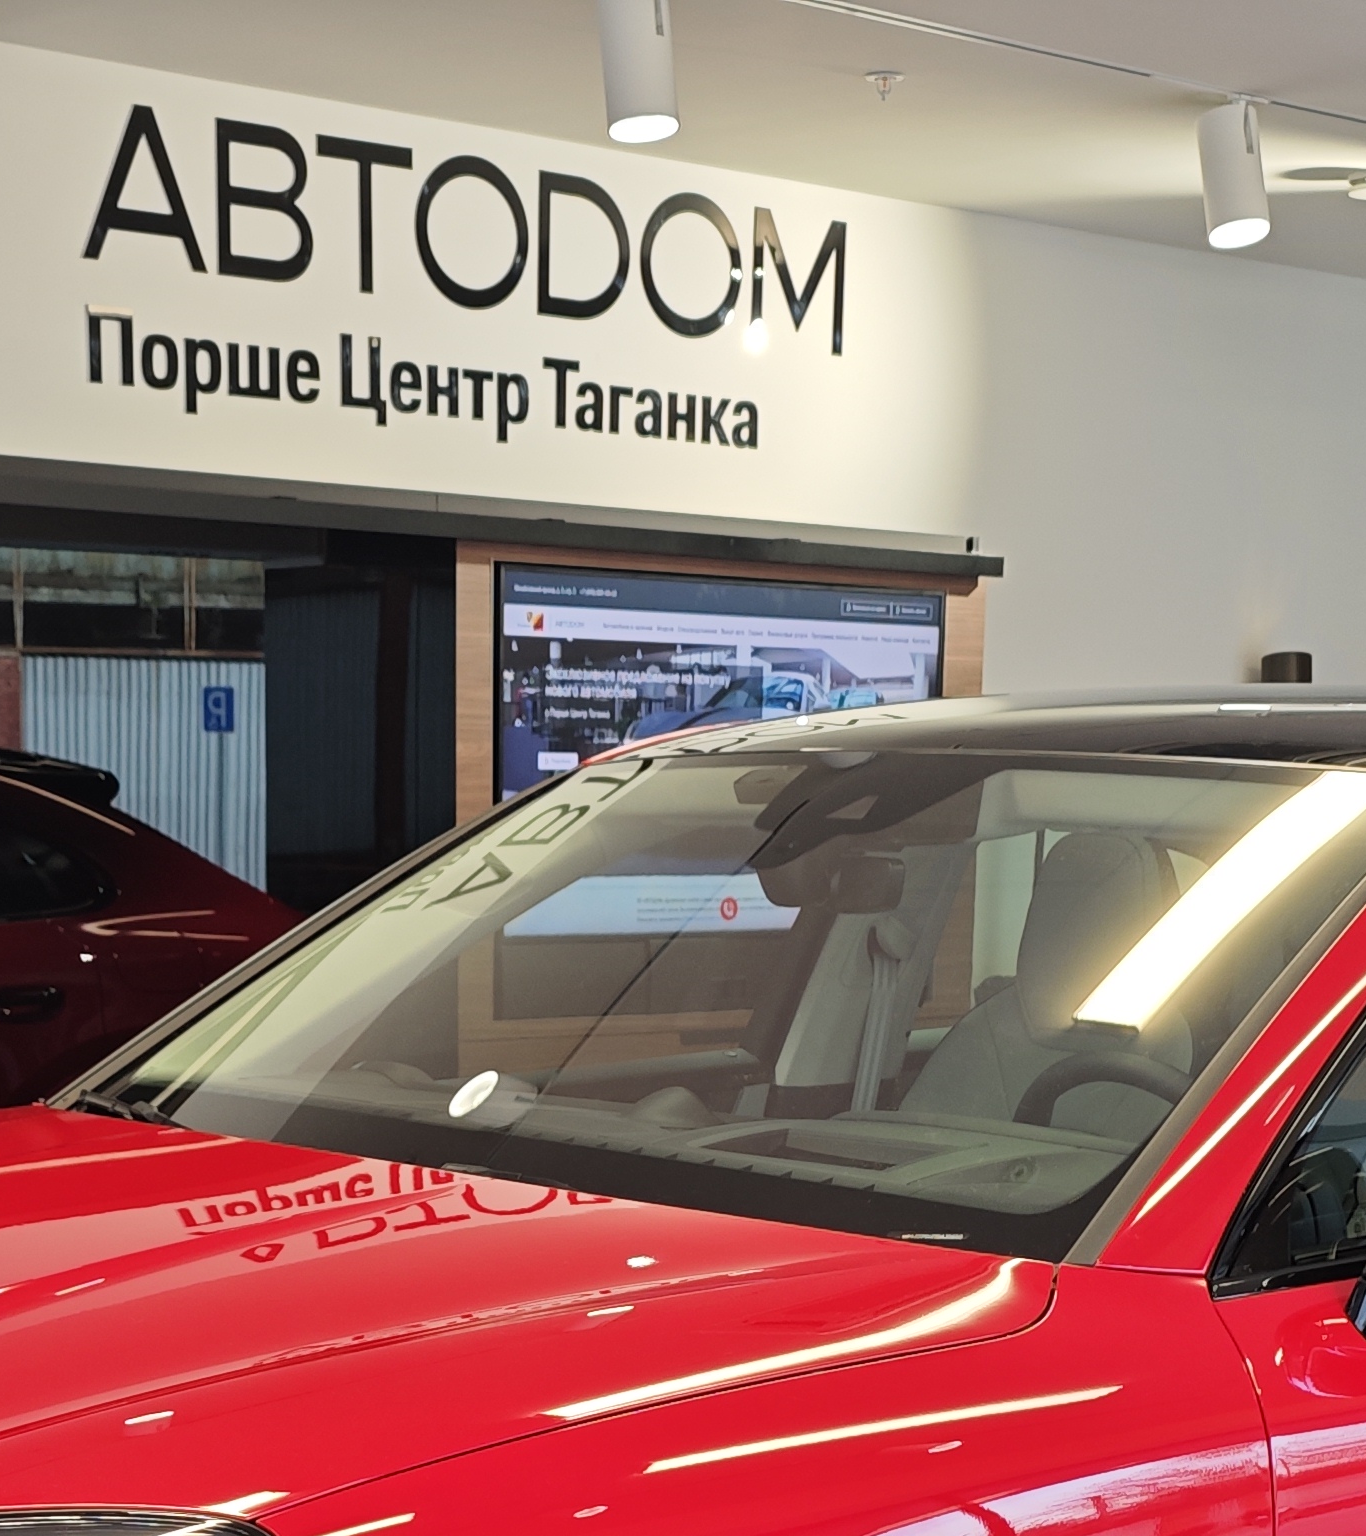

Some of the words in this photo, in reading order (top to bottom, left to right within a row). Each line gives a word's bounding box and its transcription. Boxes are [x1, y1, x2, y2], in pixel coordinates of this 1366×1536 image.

[84, 304, 321, 414] Порше
[339, 333, 530, 443] Центр
[543, 357, 760, 449] Таганка
